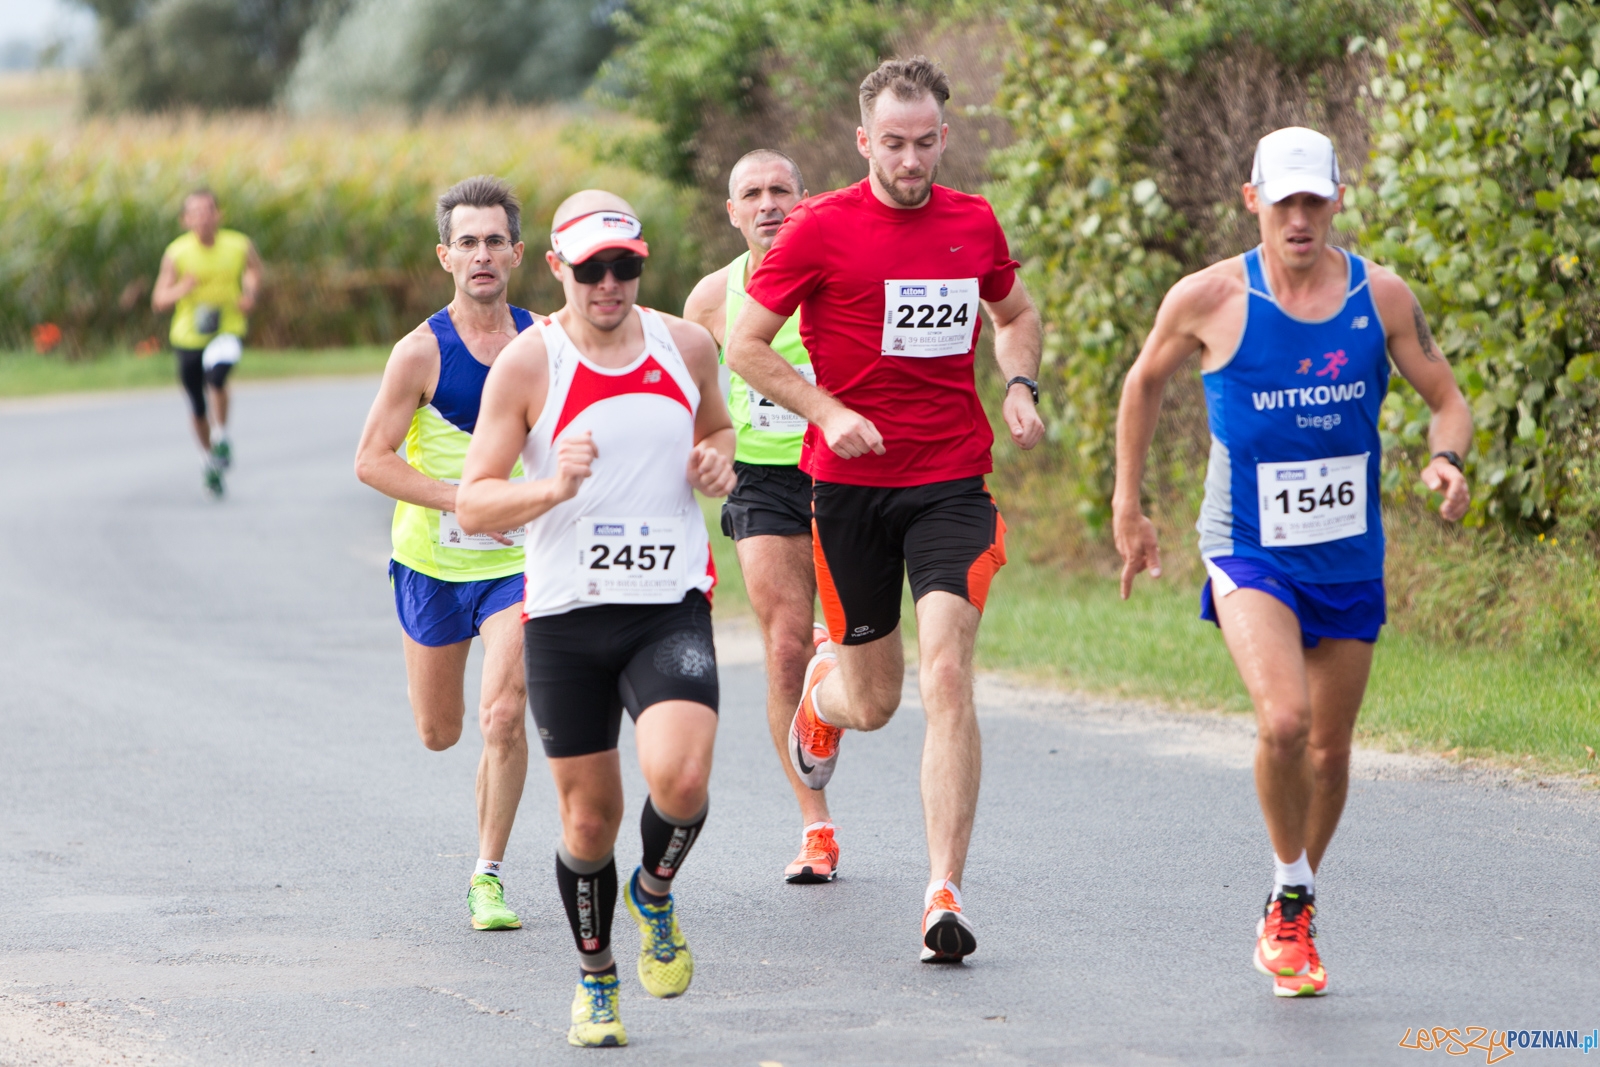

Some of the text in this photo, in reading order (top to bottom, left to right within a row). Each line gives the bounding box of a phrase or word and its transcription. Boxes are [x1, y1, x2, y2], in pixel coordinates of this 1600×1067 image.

[896, 303, 968, 328] 2224
[1252, 380, 1366, 411] WITKOWO
[1296, 413, 1342, 431] biega
[1275, 481, 1355, 514] 1546
[590, 544, 676, 571] 2457
